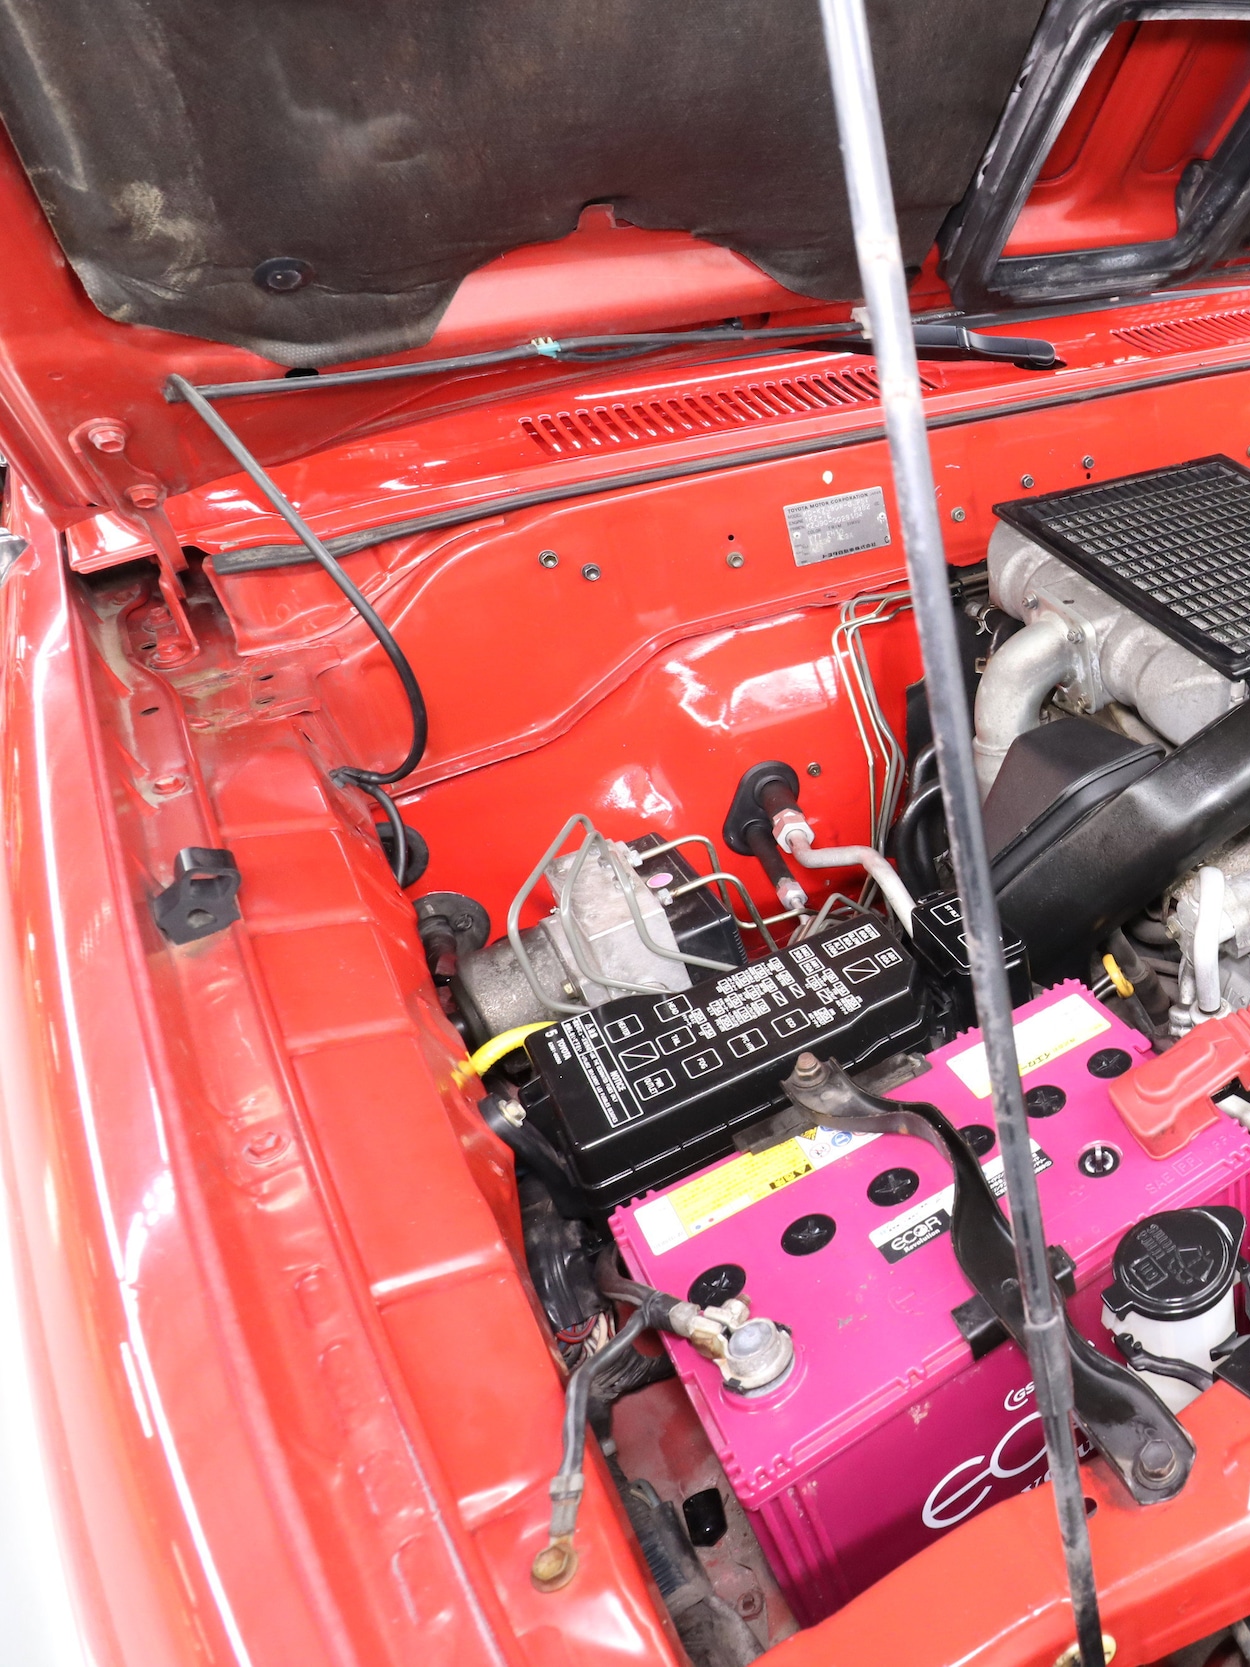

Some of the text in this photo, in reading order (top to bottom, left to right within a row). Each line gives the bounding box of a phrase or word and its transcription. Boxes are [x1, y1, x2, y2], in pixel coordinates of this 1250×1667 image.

[787, 505, 808, 513] TOYOTA
[830, 493, 868, 504] CORPORATION
[545, 1029, 558, 1037] 5
[556, 1038, 571, 1060] TOYOTA
[610, 1070, 626, 1092] NOTICE
[904, 1229, 940, 1253] Revolution
